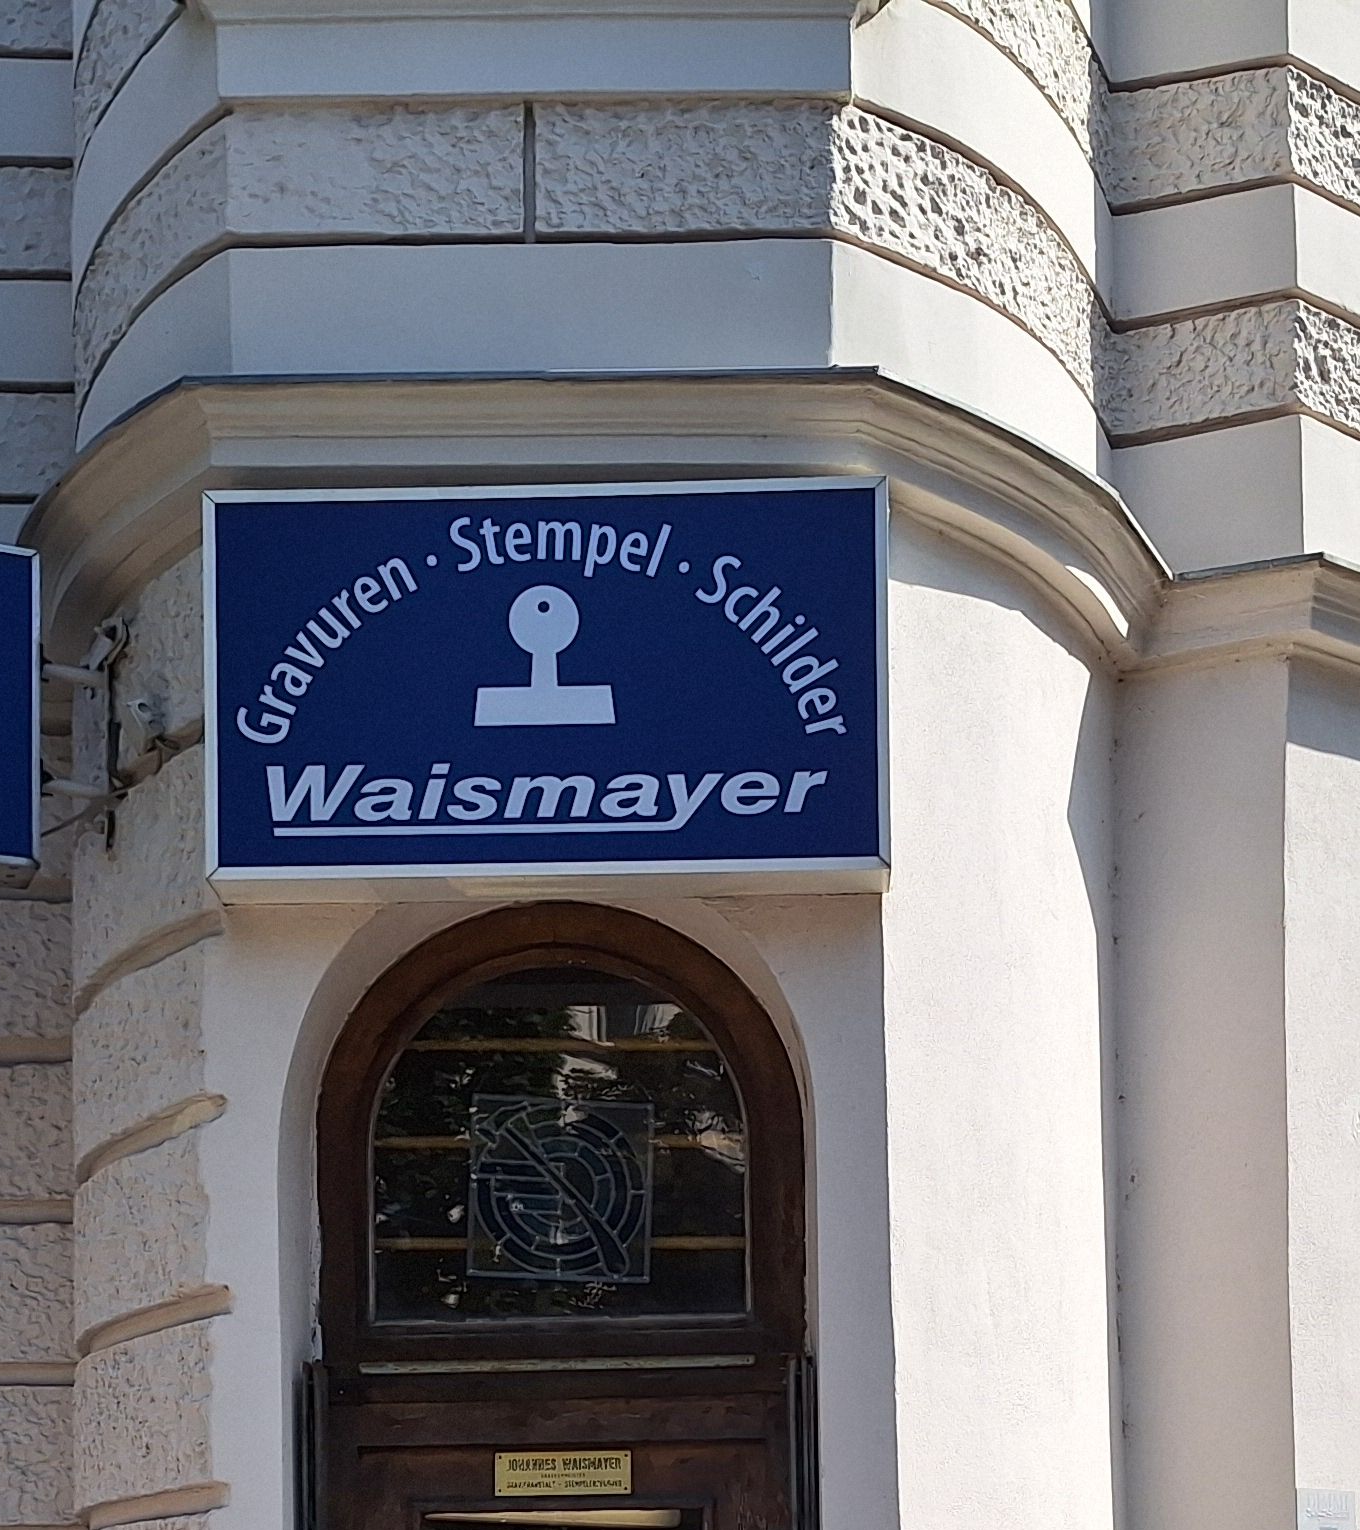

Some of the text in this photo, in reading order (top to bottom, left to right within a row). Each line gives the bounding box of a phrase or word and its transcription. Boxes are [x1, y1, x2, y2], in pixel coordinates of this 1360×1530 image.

[238, 516, 847, 745] Gravuren Stempel Schilder
[265, 762, 829, 837] Waismayer
[561, 1457, 622, 1471] WAISMAYER
